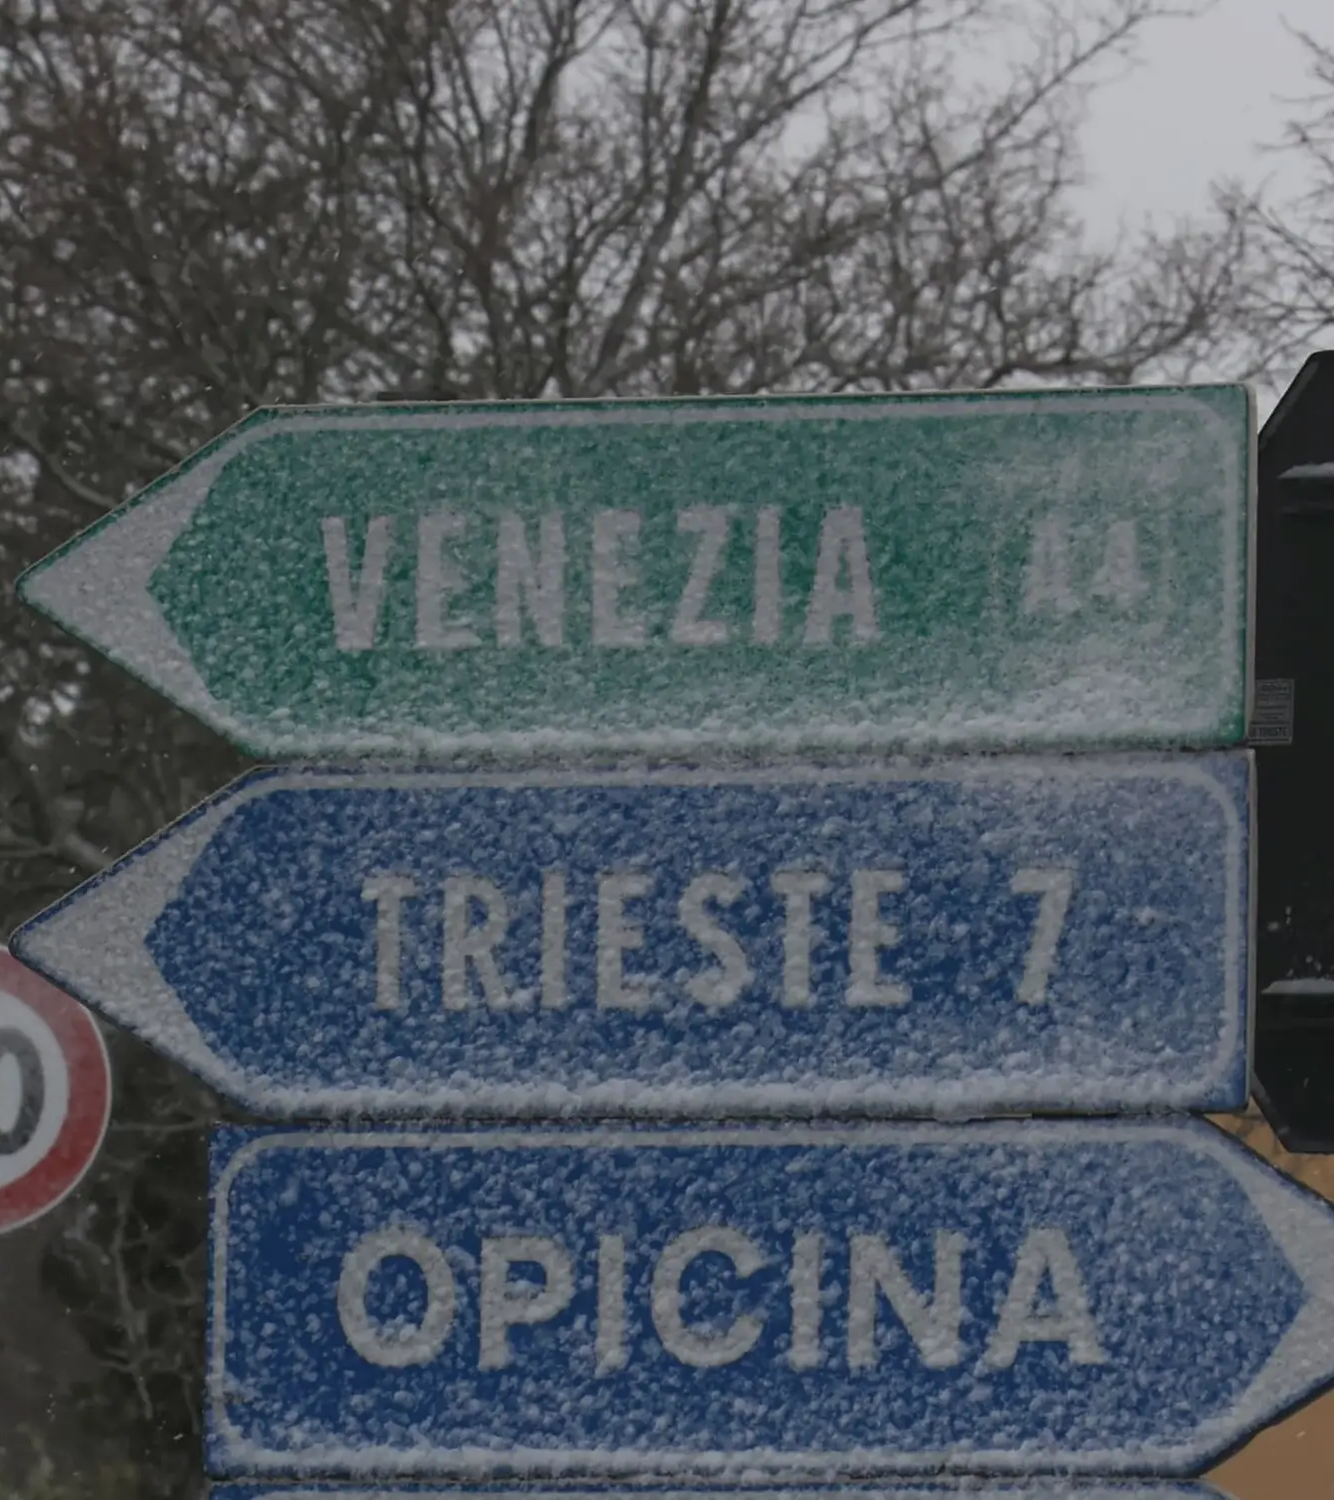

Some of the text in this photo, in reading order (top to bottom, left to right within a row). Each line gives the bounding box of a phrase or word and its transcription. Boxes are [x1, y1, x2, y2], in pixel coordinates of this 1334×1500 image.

[322, 502, 876, 651] VENEZIA
[362, 868, 1072, 1010] TRIESTE 7
[335, 1224, 1110, 1375] OPICINA
